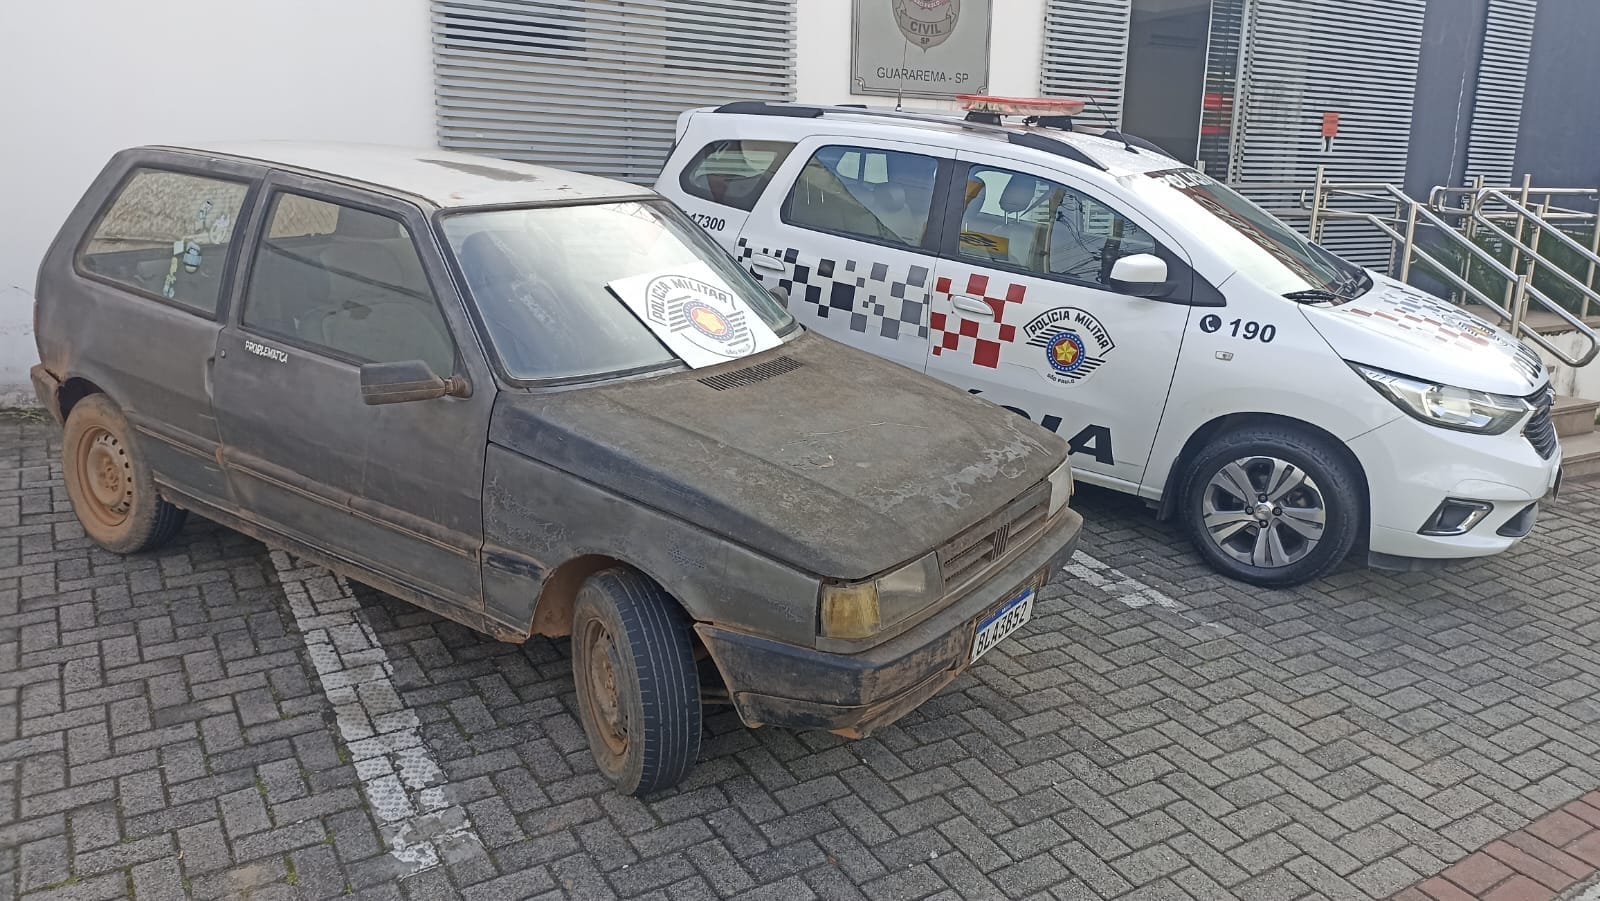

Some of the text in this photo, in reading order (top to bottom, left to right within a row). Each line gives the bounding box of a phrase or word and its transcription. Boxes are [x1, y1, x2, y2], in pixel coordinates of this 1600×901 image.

[910, 21, 941, 34] CIVIL
[877, 66, 946, 82] GUARAREMA
[955, 72, 969, 84] SP
[671, 278, 728, 304] MILITAR
[1074, 312, 1110, 349] MILITAR
[1229, 318, 1276, 343] 190
